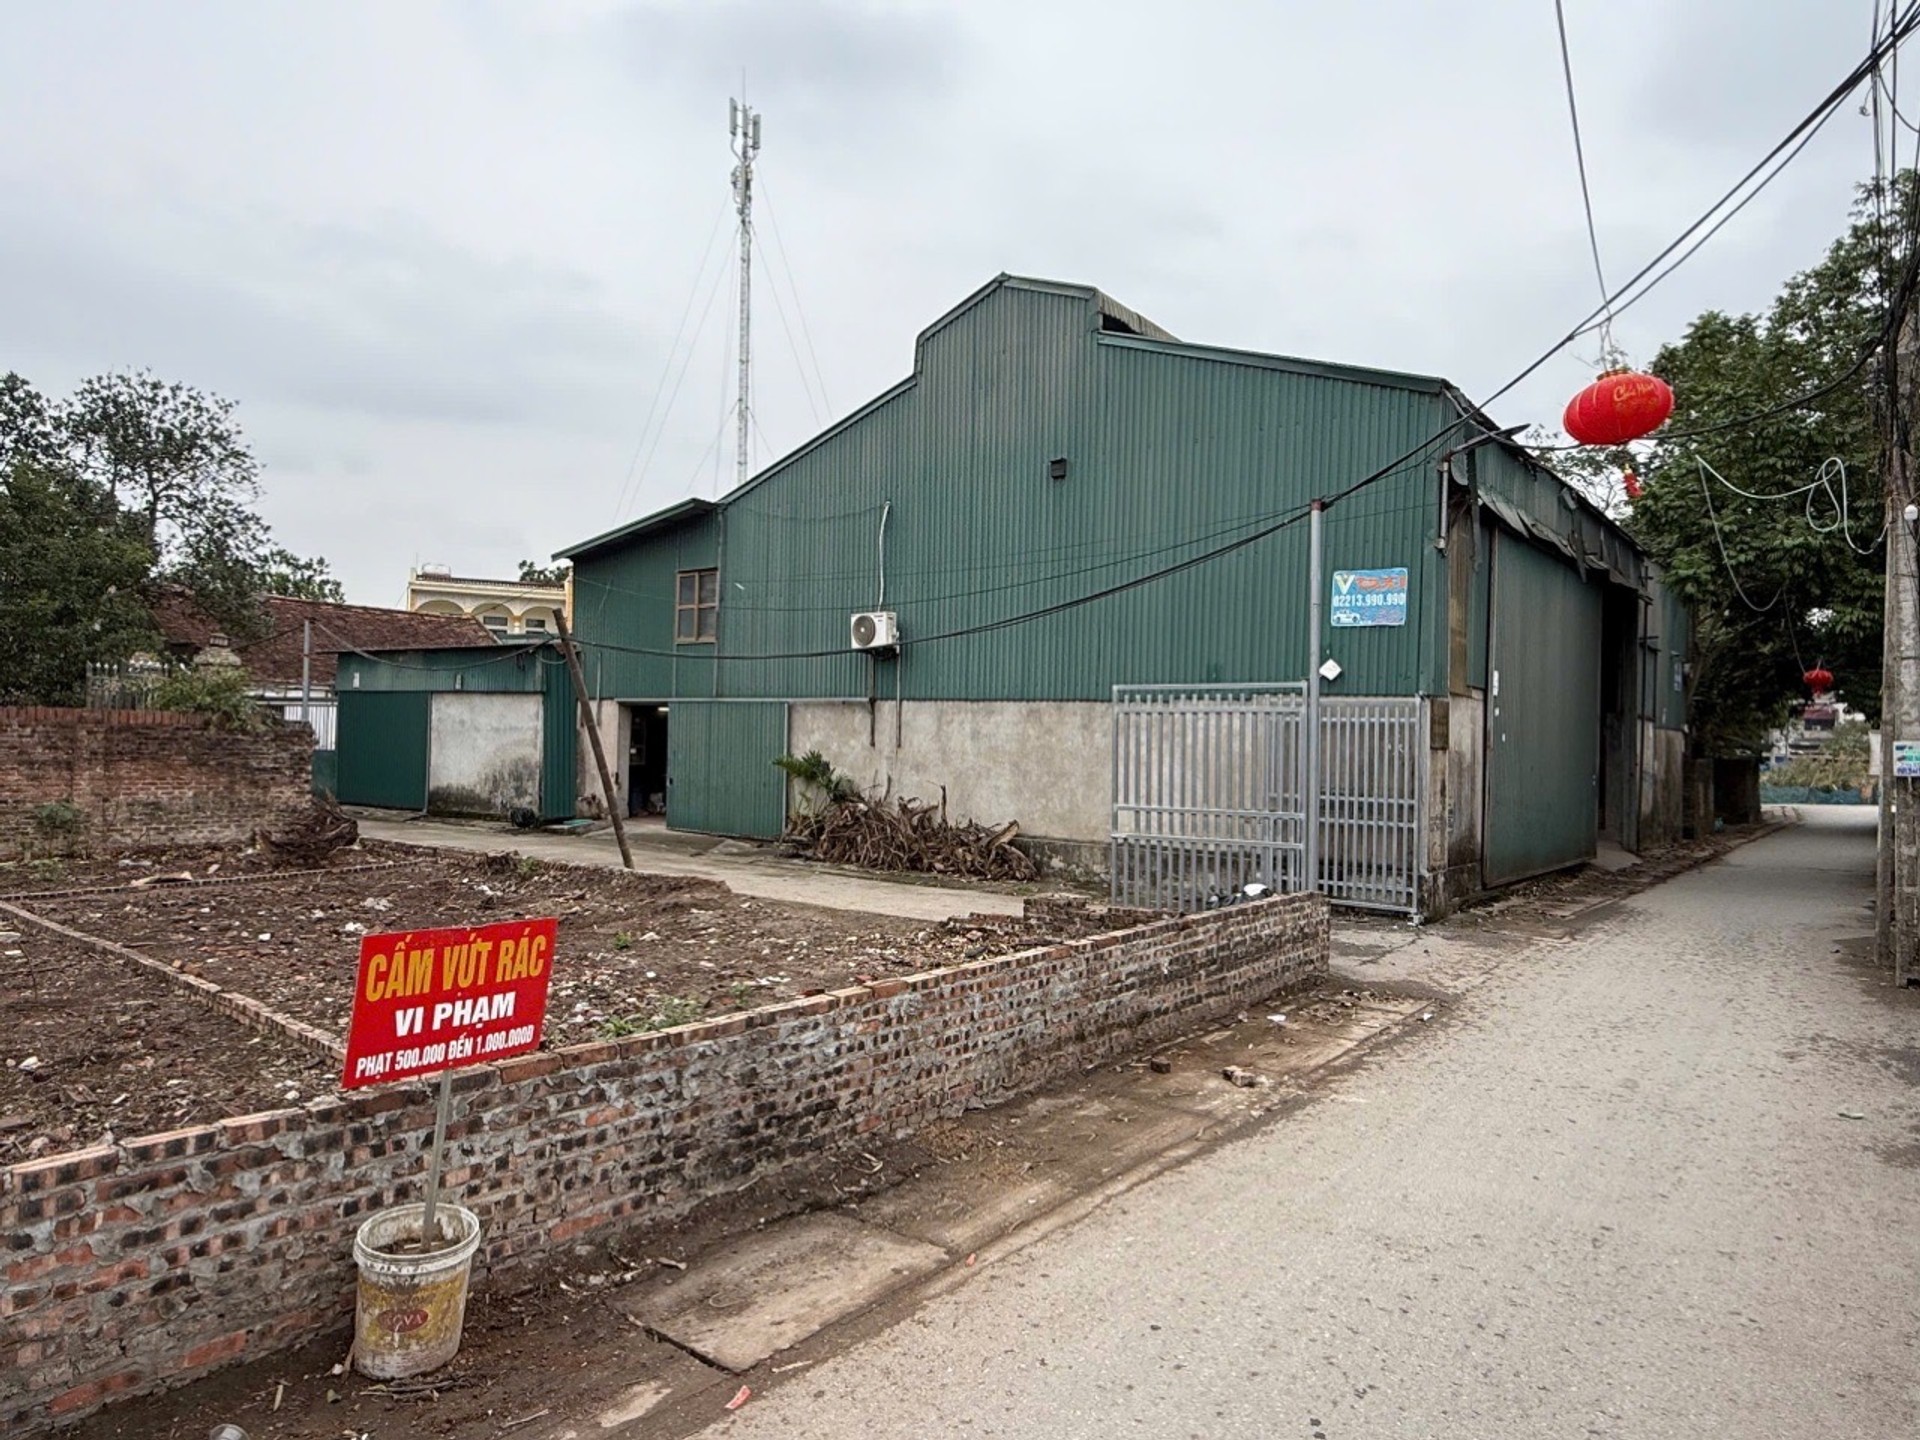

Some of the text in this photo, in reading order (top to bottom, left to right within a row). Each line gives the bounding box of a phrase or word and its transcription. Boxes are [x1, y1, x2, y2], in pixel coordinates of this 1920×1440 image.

[365, 927, 547, 1002] CẤM VỨT RÁC
[395, 991, 516, 1037] VI PHẠM
[355, 1051, 393, 1079] PHẠT
[394, 1042, 446, 1071] 500.000
[447, 1032, 473, 1060] ĐẾN
